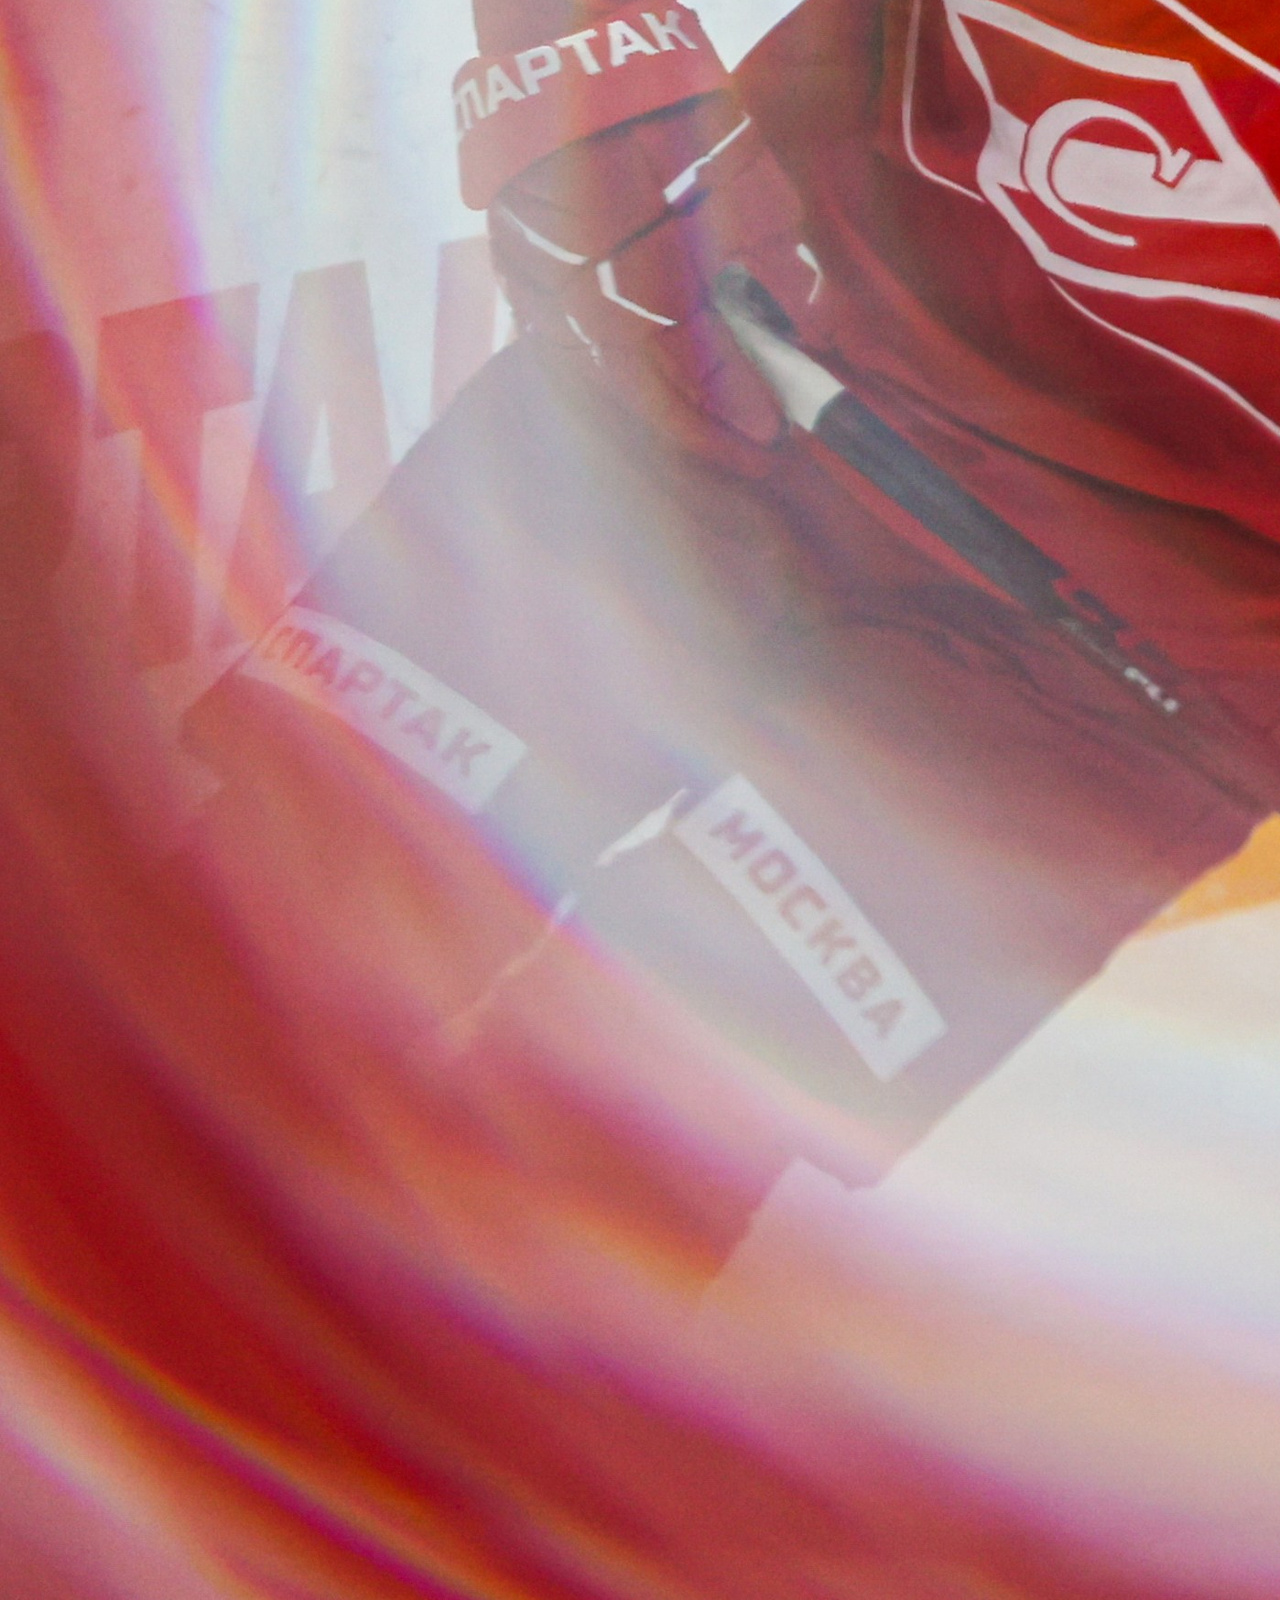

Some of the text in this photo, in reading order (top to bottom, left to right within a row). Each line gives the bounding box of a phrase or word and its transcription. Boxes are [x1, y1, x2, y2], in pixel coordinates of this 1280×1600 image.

[454, 10, 698, 130] ПАРТАК
[262, 625, 493, 778] СПАРТАК
[707, 809, 907, 1041] МОСКВА
